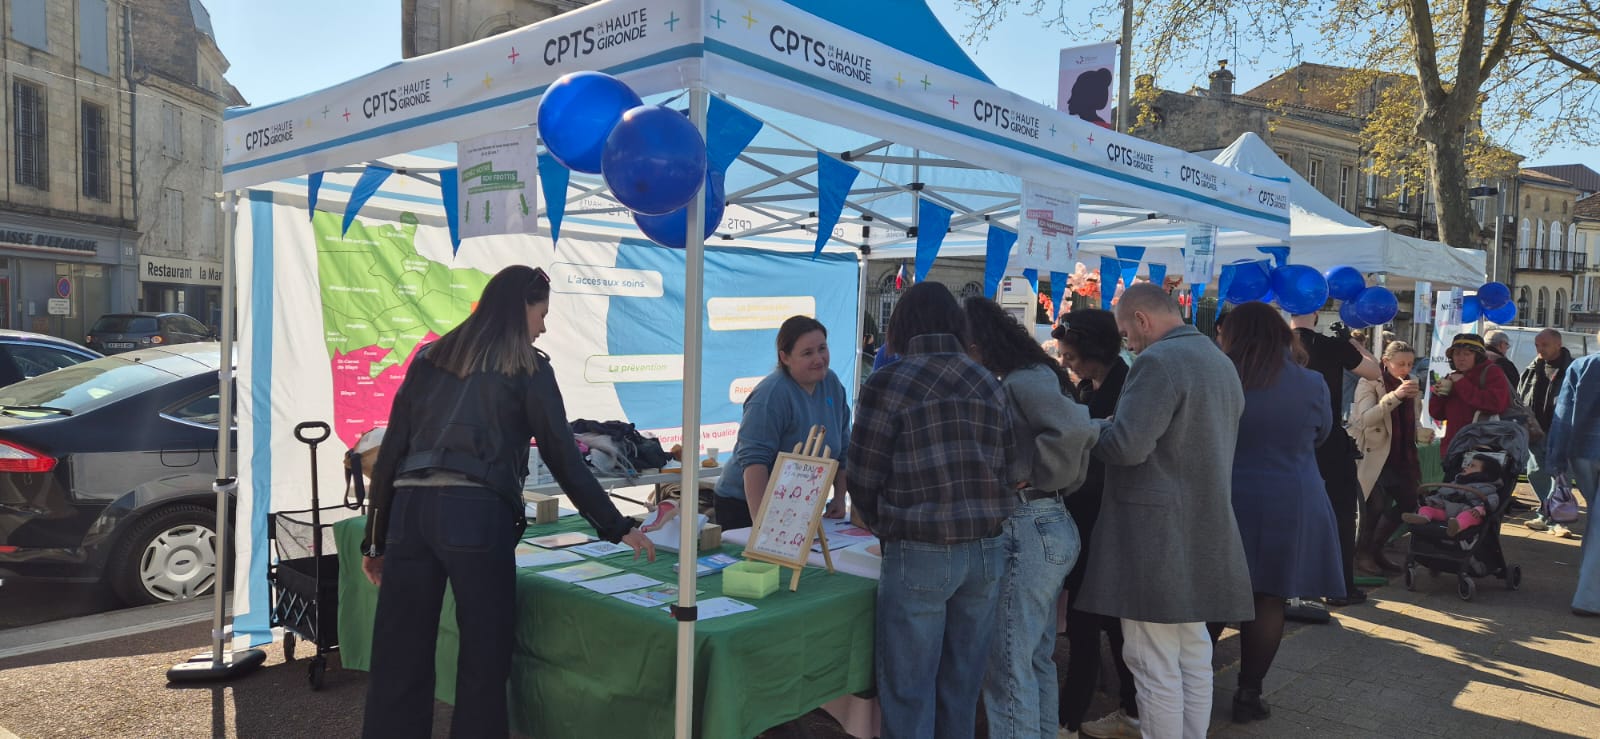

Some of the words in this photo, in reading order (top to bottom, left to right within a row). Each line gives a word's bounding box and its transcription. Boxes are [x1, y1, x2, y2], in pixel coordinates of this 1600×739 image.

[605, 8, 647, 33] HAUTE
[543, 26, 595, 66] CPTS
[597, 24, 647, 50] GIRONDE
[769, 25, 826, 67] CPTS
[836, 48, 872, 71] HAUTE
[828, 60, 872, 84] GIRONDE
[403, 78, 431, 96] HAUTE
[363, 89, 398, 119] CPTS
[398, 91, 431, 109] GIRONDE
[974, 99, 1010, 129] CPTS
[1015, 113, 1040, 128] HAUTE
[273, 119, 293, 133] HAUTE
[1010, 122, 1039, 139] GIRONDE
[245, 127, 270, 151] CPTS
[270, 130, 294, 144] GIRONDE
[1107, 143, 1133, 166] CPTS
[1136, 151, 1154, 163] HAUTE
[1180, 165, 1201, 186] CPTS
[1258, 190, 1274, 206] CPTS
[0, 229, 33, 245] AISSE
[147, 261, 192, 279] Restaurant
[199, 266, 206, 280] la
[208, 267, 223, 281] Mar
[602, 279, 618, 287] aux
[622, 278, 645, 288] soins
